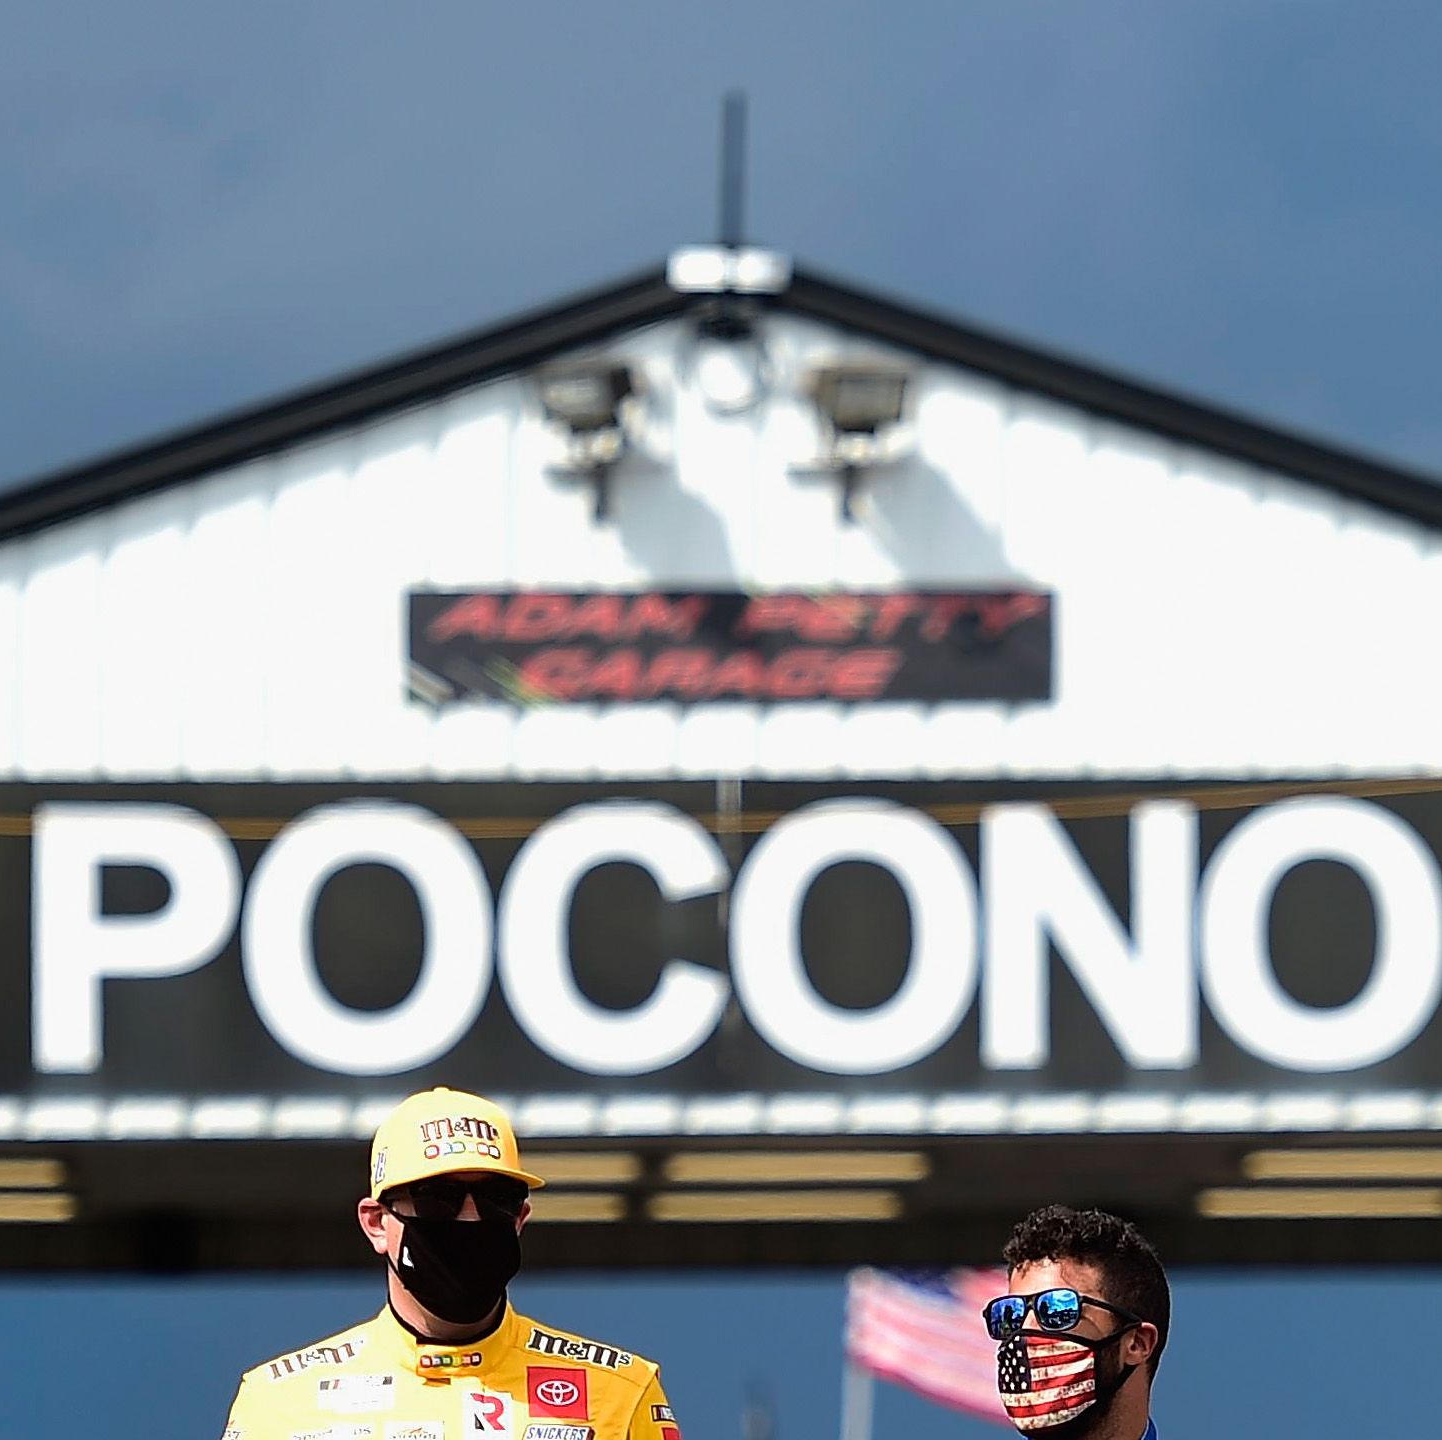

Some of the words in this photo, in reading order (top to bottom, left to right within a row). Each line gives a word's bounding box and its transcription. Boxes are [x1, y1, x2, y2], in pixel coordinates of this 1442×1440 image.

[427, 596, 705, 642] ADAM
[735, 595, 1045, 644] PETTY
[515, 648, 901, 699] GARAGE
